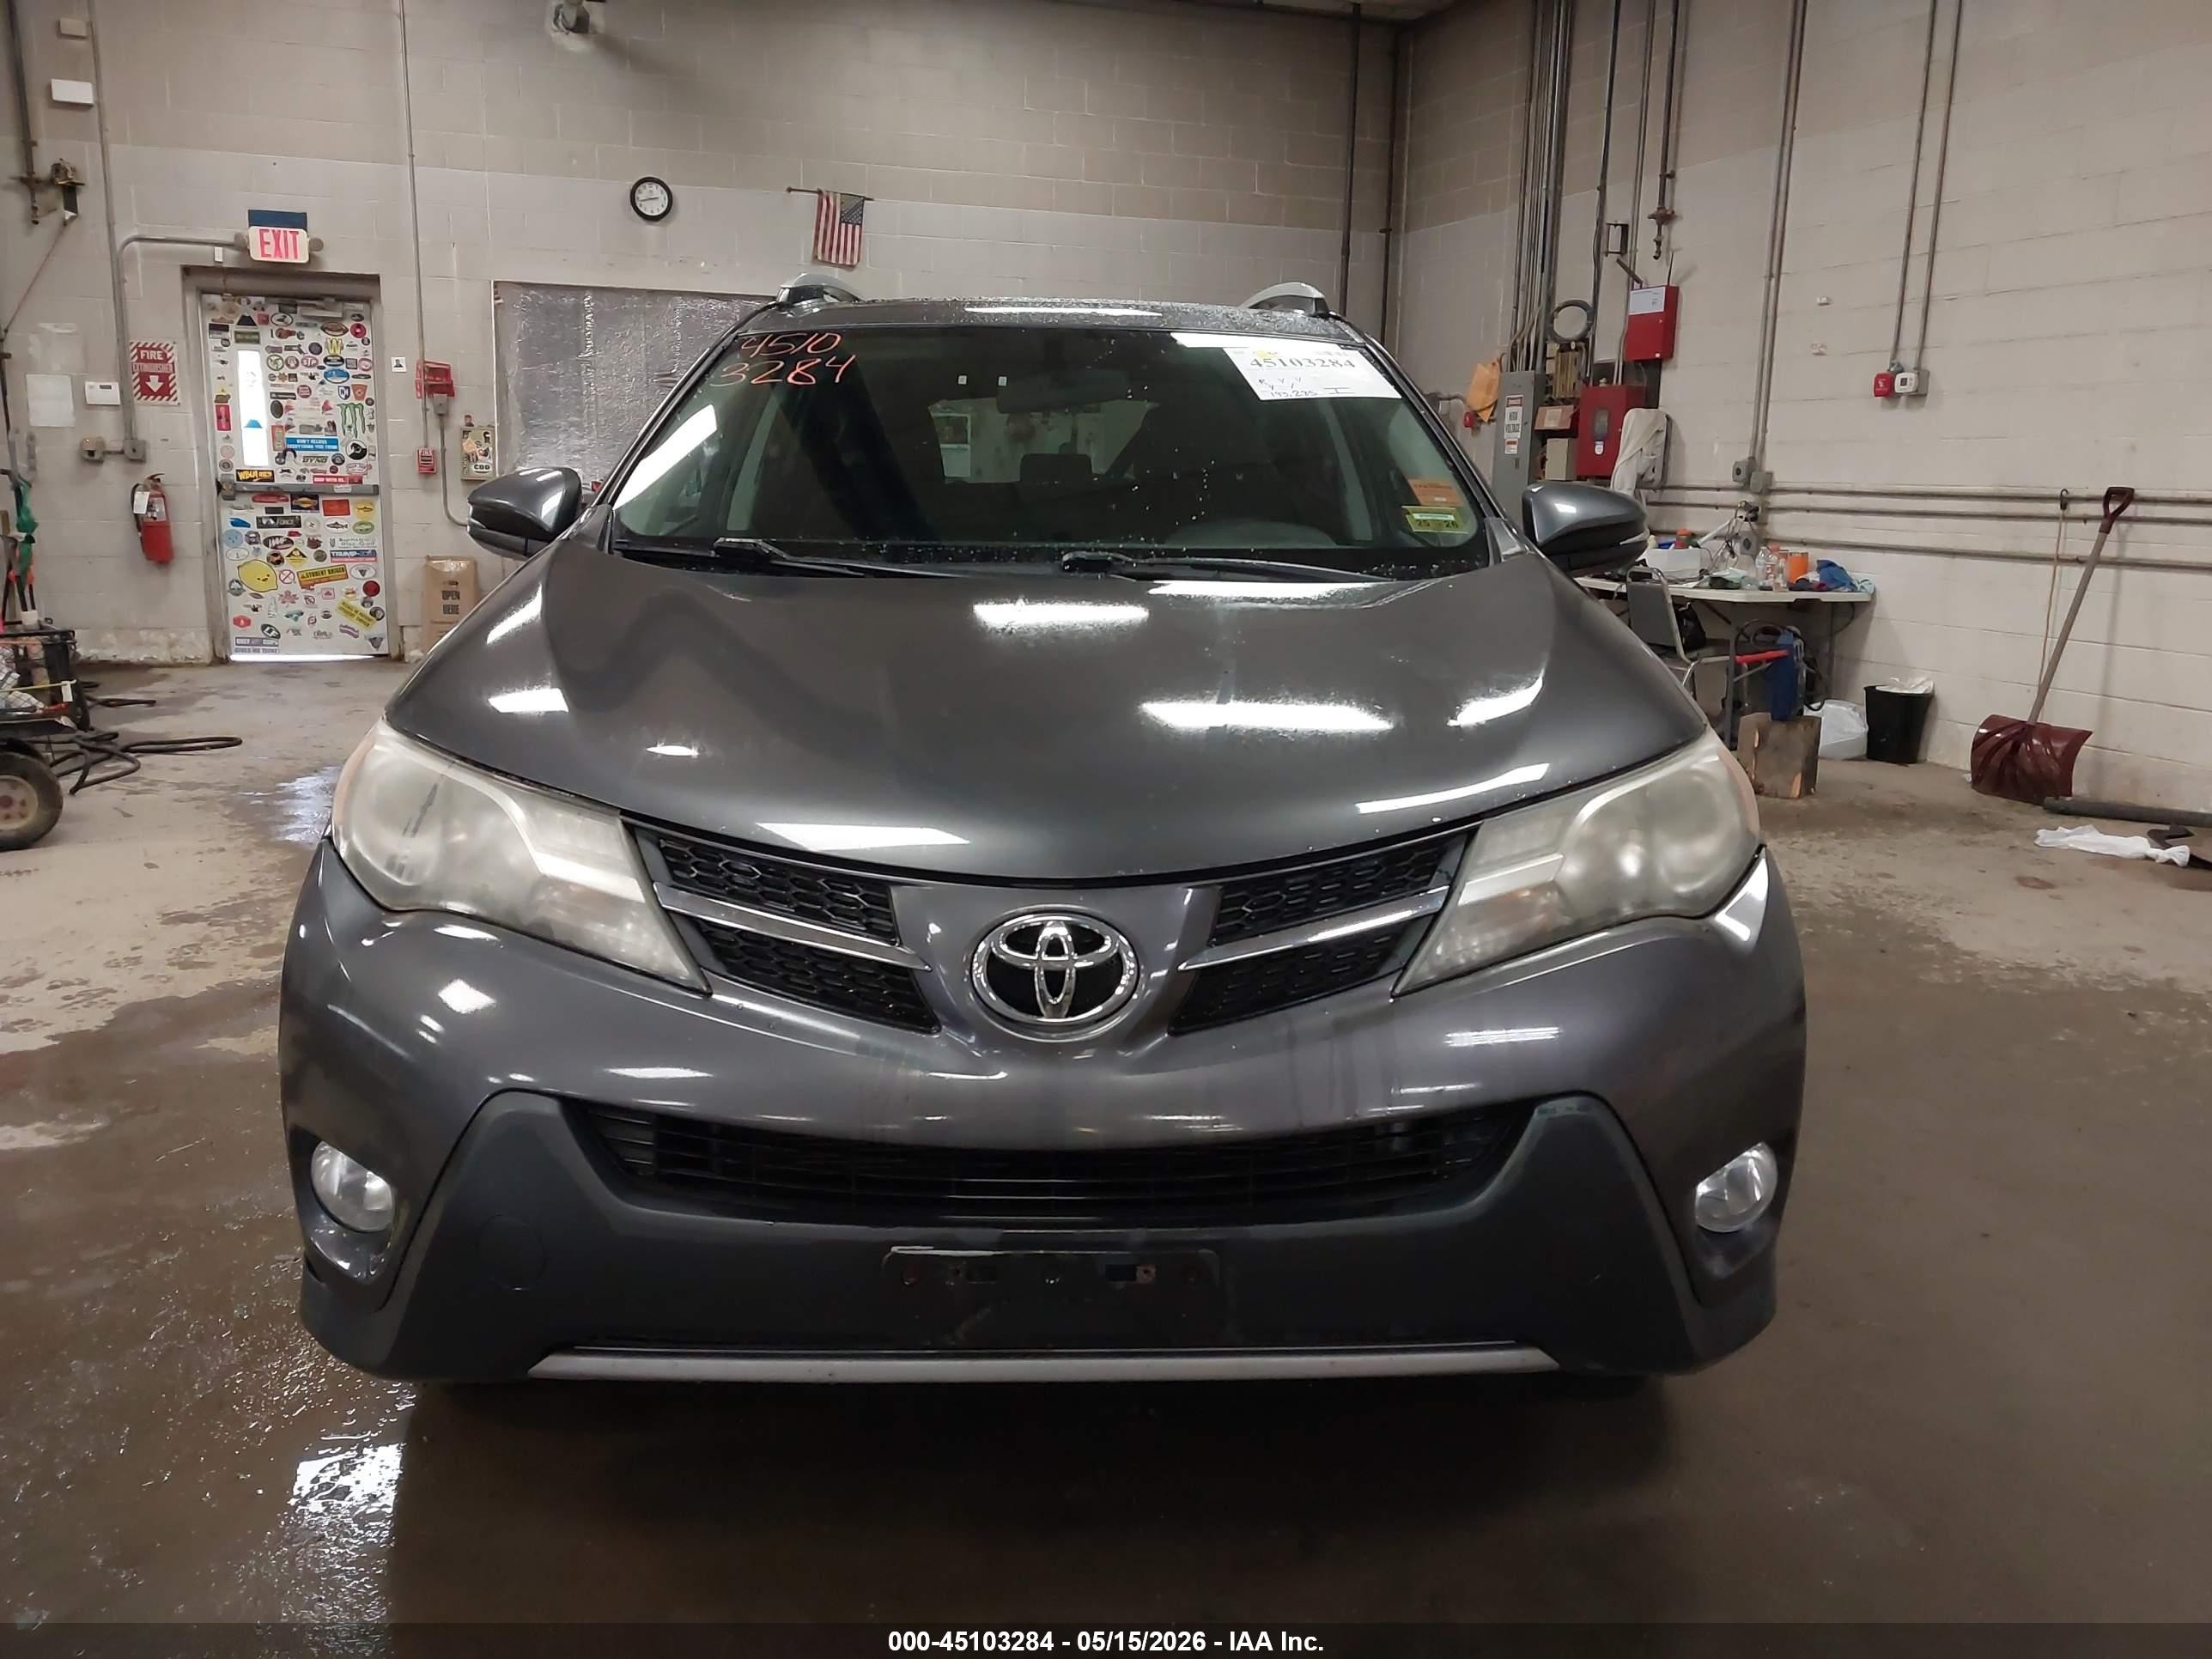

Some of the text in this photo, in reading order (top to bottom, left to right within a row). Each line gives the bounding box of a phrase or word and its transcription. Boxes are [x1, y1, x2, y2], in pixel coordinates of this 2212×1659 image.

[258, 229, 300, 259] EXIT
[140, 349, 164, 361] FIRE
[741, 332, 842, 358] 4510
[709, 354, 857, 386] 3284
[1250, 357, 1356, 368] 45103284
